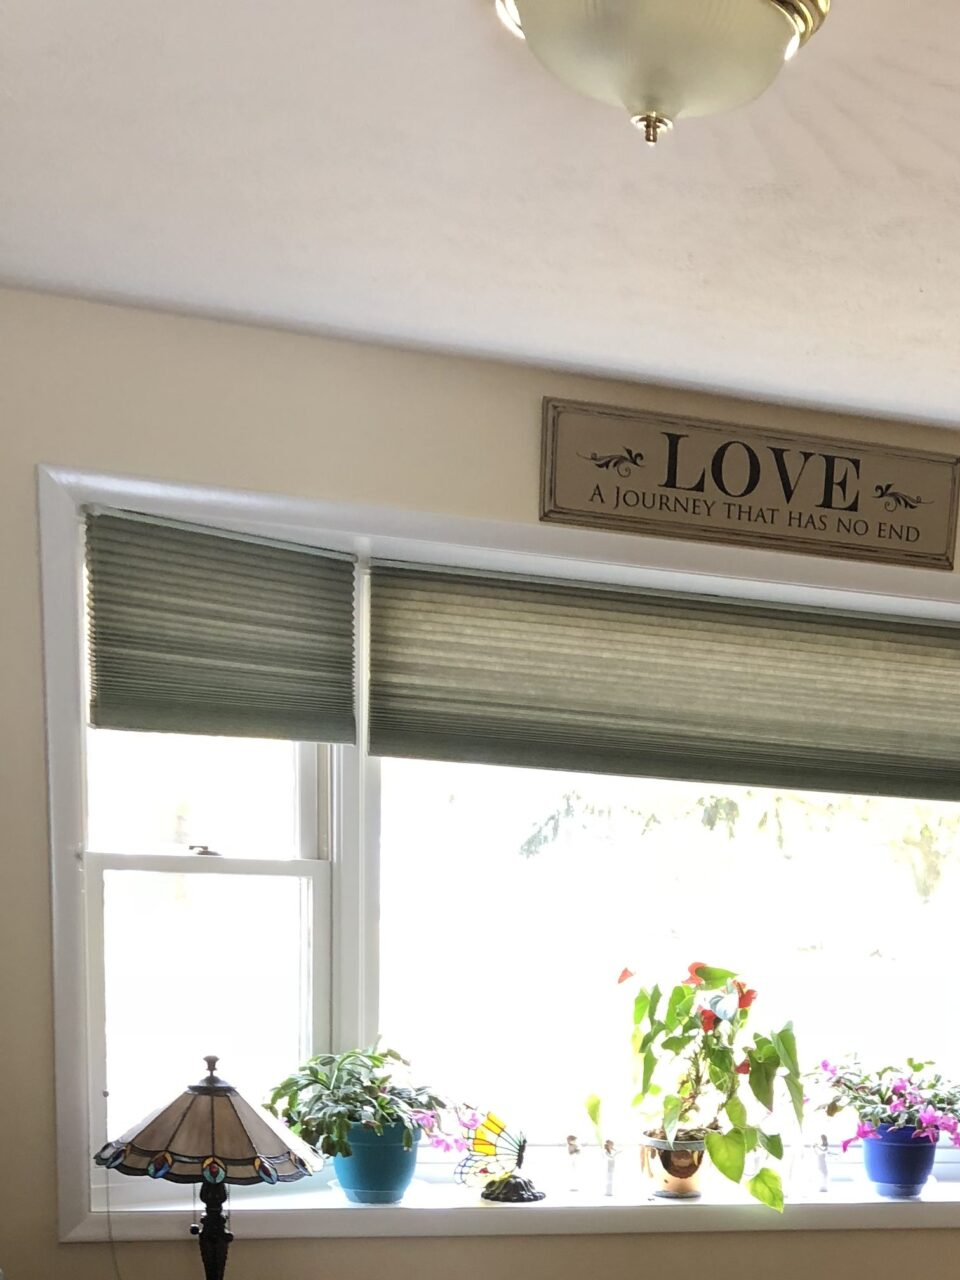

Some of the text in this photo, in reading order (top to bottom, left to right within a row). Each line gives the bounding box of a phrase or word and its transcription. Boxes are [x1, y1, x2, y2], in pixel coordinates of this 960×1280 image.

[657, 431, 860, 512] LOVE
[588, 483, 920, 543] A JOURNEY THAT HAS NO END
